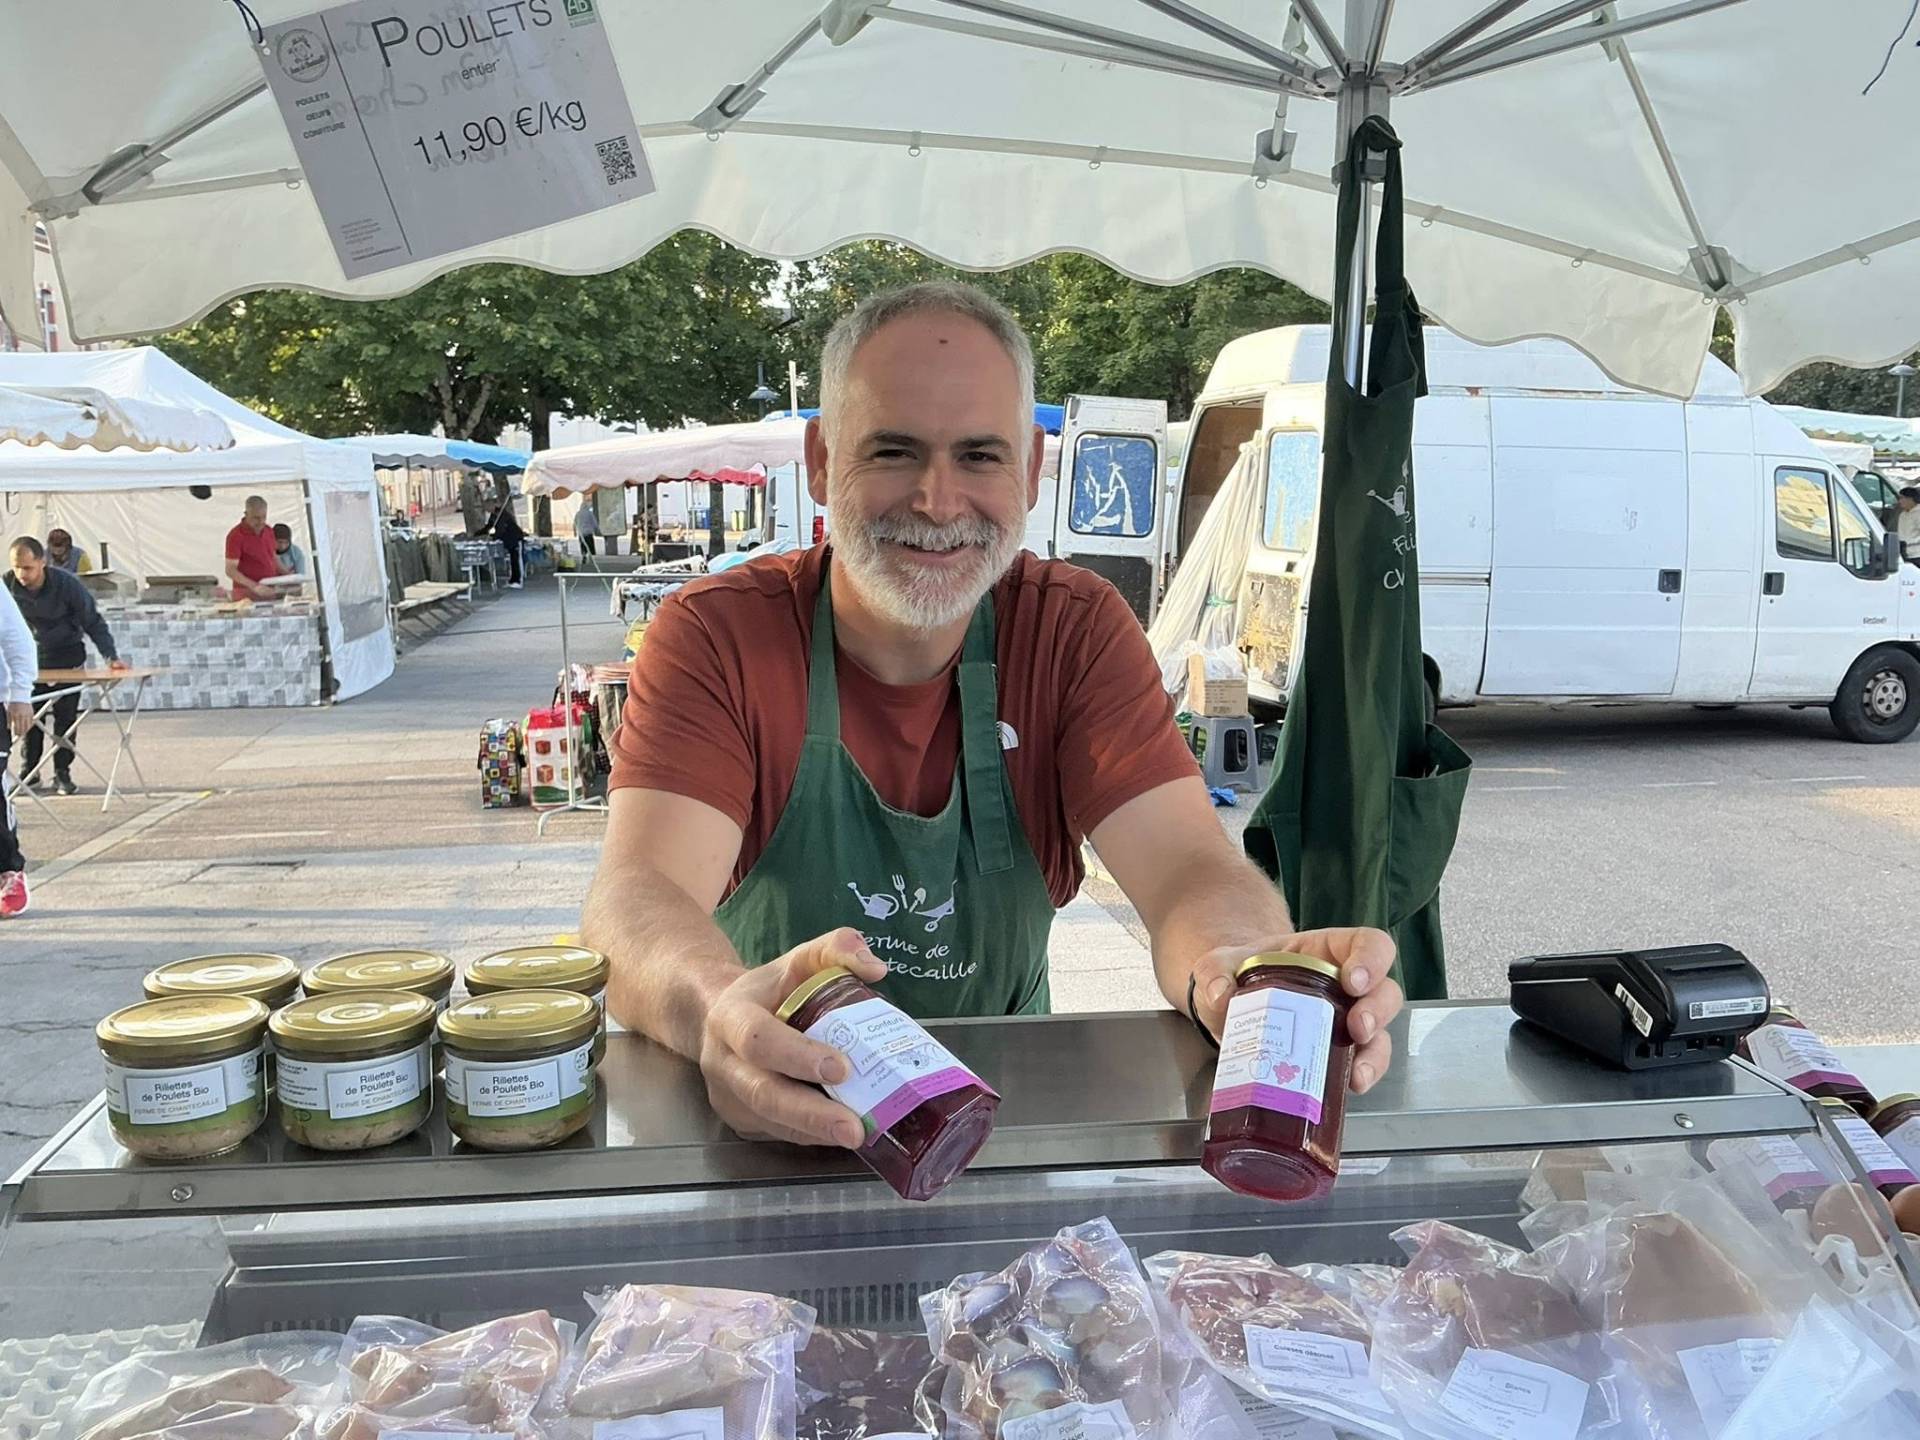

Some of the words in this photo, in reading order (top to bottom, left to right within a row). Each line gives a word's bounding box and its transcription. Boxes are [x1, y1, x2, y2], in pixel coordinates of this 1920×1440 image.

[296, 92, 330, 107] POULETS
[303, 121, 346, 139] CONFITURE
[413, 116, 506, 164] 11,90
[515, 100, 586, 137] €/kg
[857, 931, 919, 955] erme
[925, 943, 950, 959] de
[360, 1070, 396, 1083] Rillettes
[492, 1075, 529, 1084] Rillettes
[154, 1081, 193, 1092] Rillettes
[345, 1087, 357, 1095] de
[360, 1080, 394, 1093] Poulets
[396, 1074, 409, 1084] Bio
[493, 1085, 527, 1094] Poulets
[529, 1080, 545, 1089] Bio
[141, 1093, 153, 1102] de
[155, 1090, 191, 1101] Poulets
[193, 1086, 209, 1096] Bio
